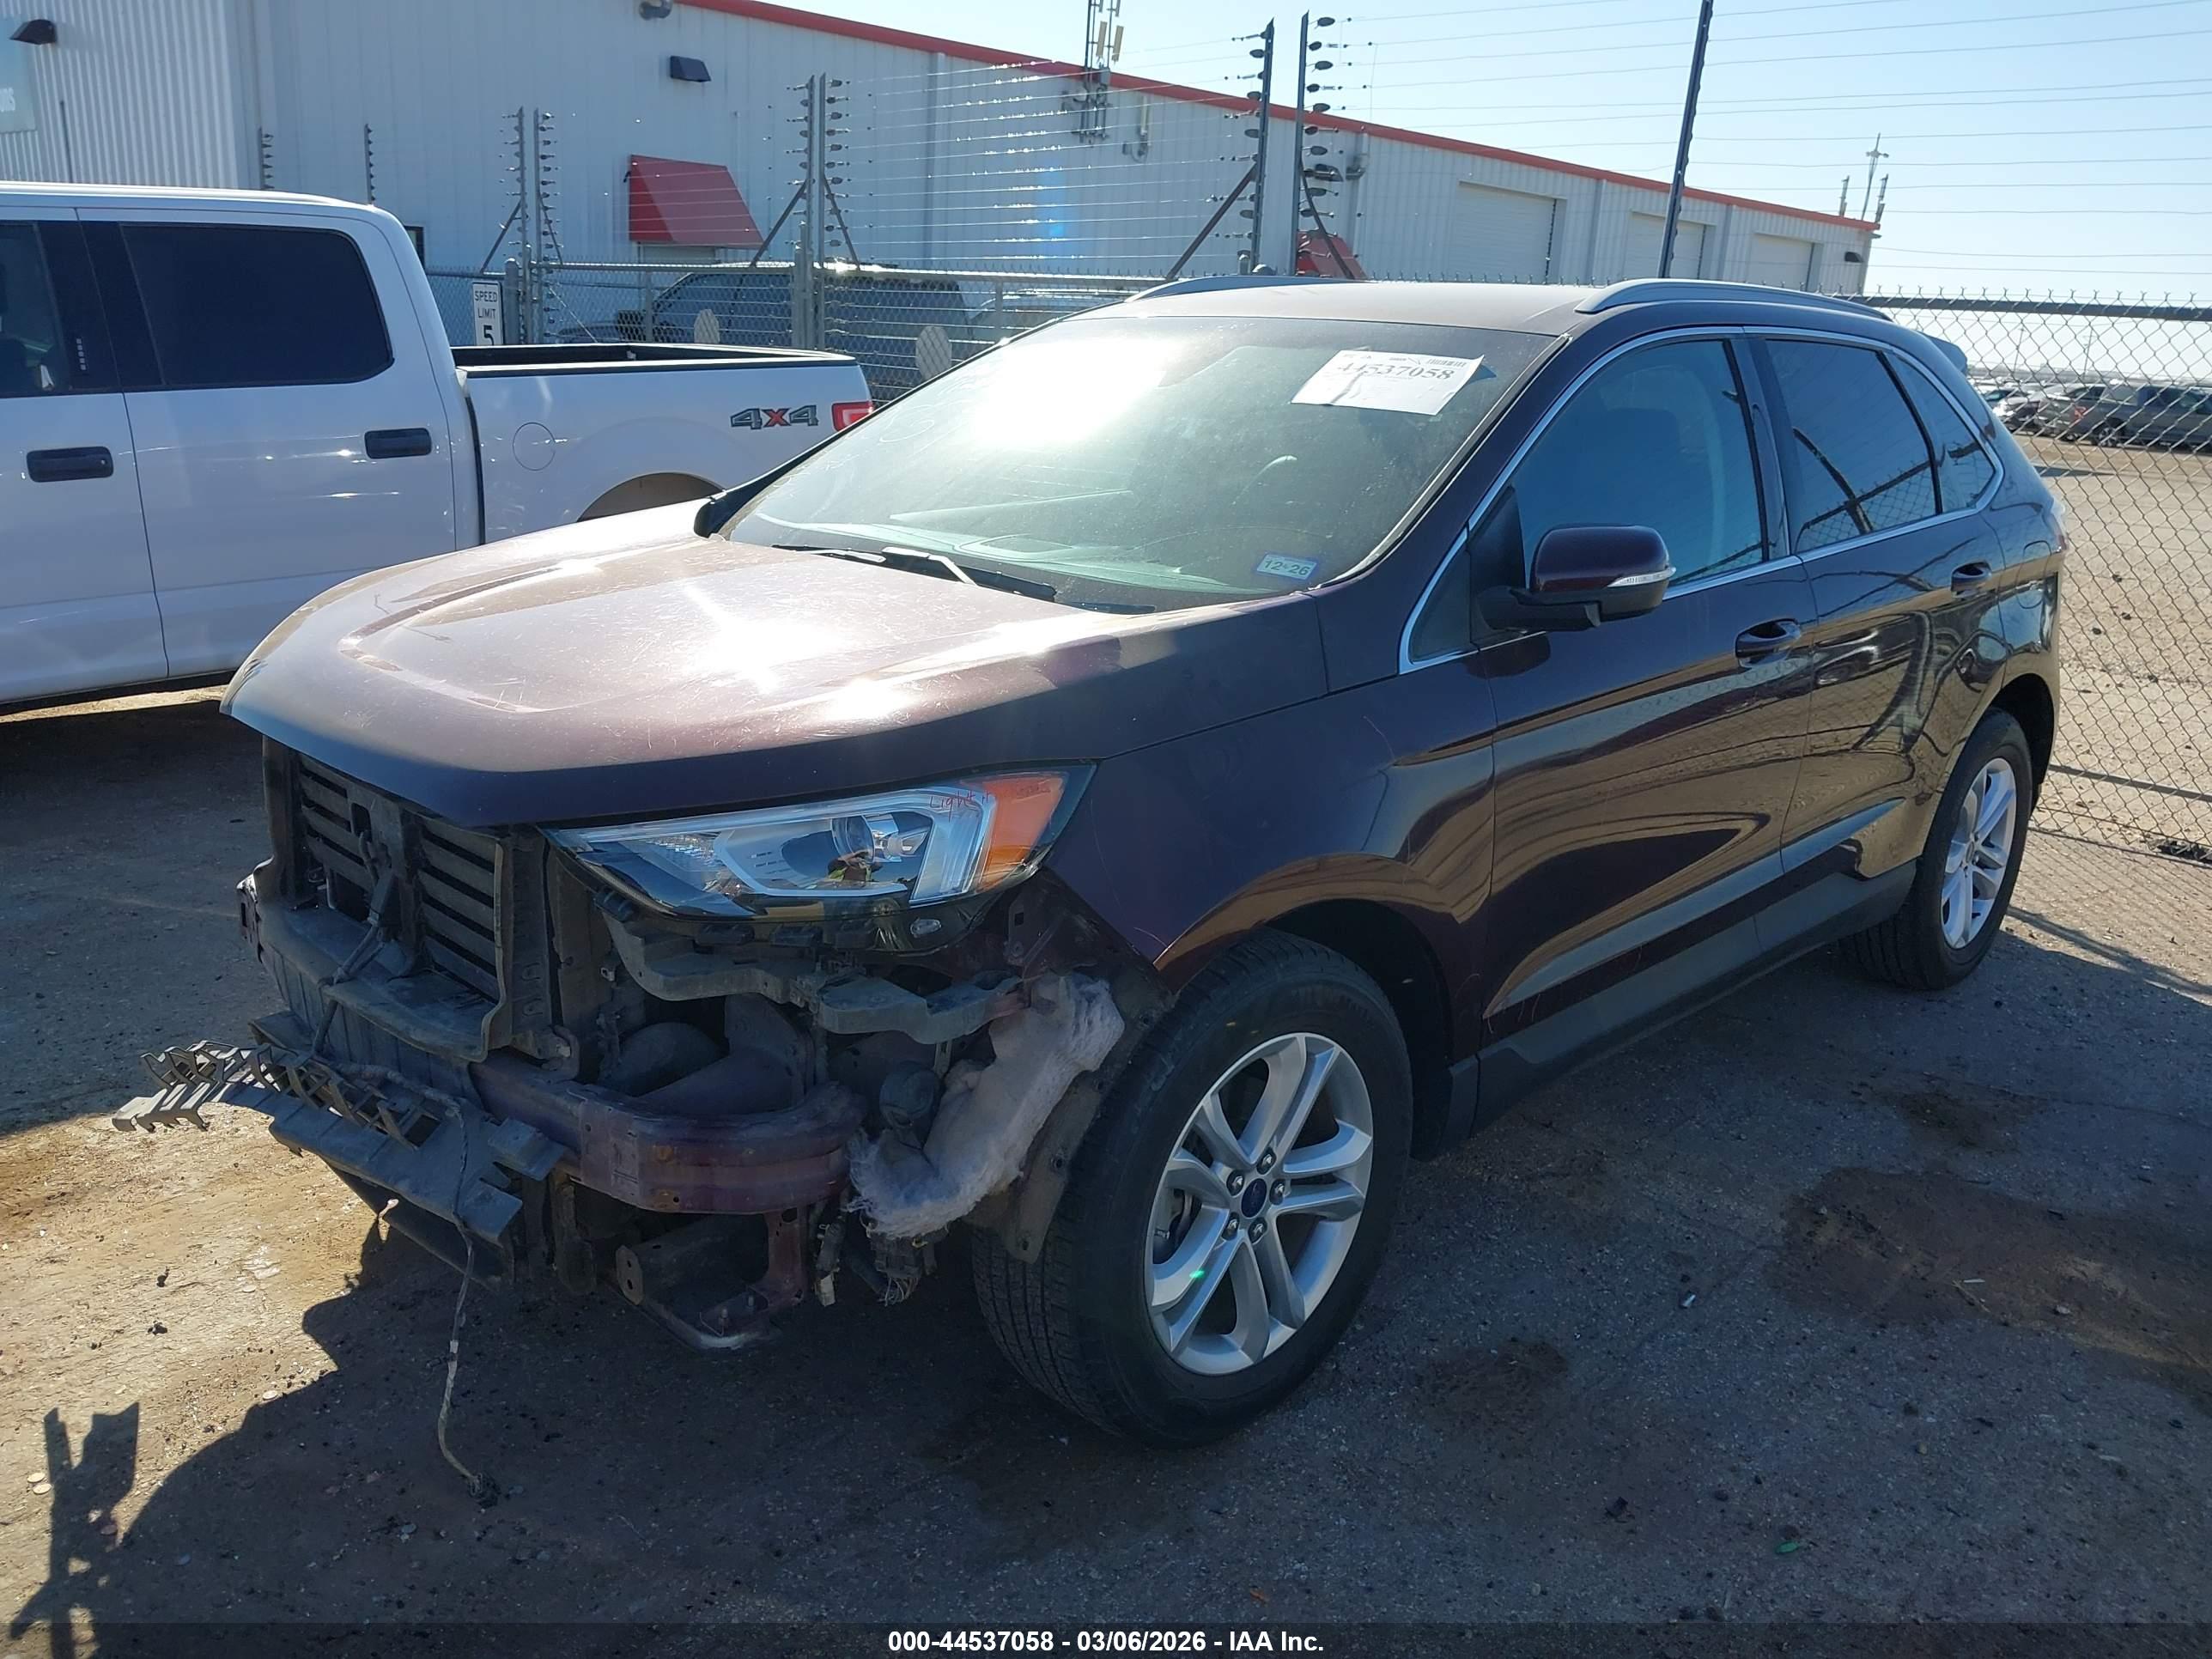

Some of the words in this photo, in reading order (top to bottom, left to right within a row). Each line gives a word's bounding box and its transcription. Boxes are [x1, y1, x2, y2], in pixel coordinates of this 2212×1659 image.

[474, 290, 498, 303] SPEED
[477, 308, 496, 319] LIMIT
[483, 325, 495, 346] 5
[1337, 362, 1455, 380] 44537058
[1265, 560, 1283, 571] 12
[1288, 564, 1310, 576] 26
